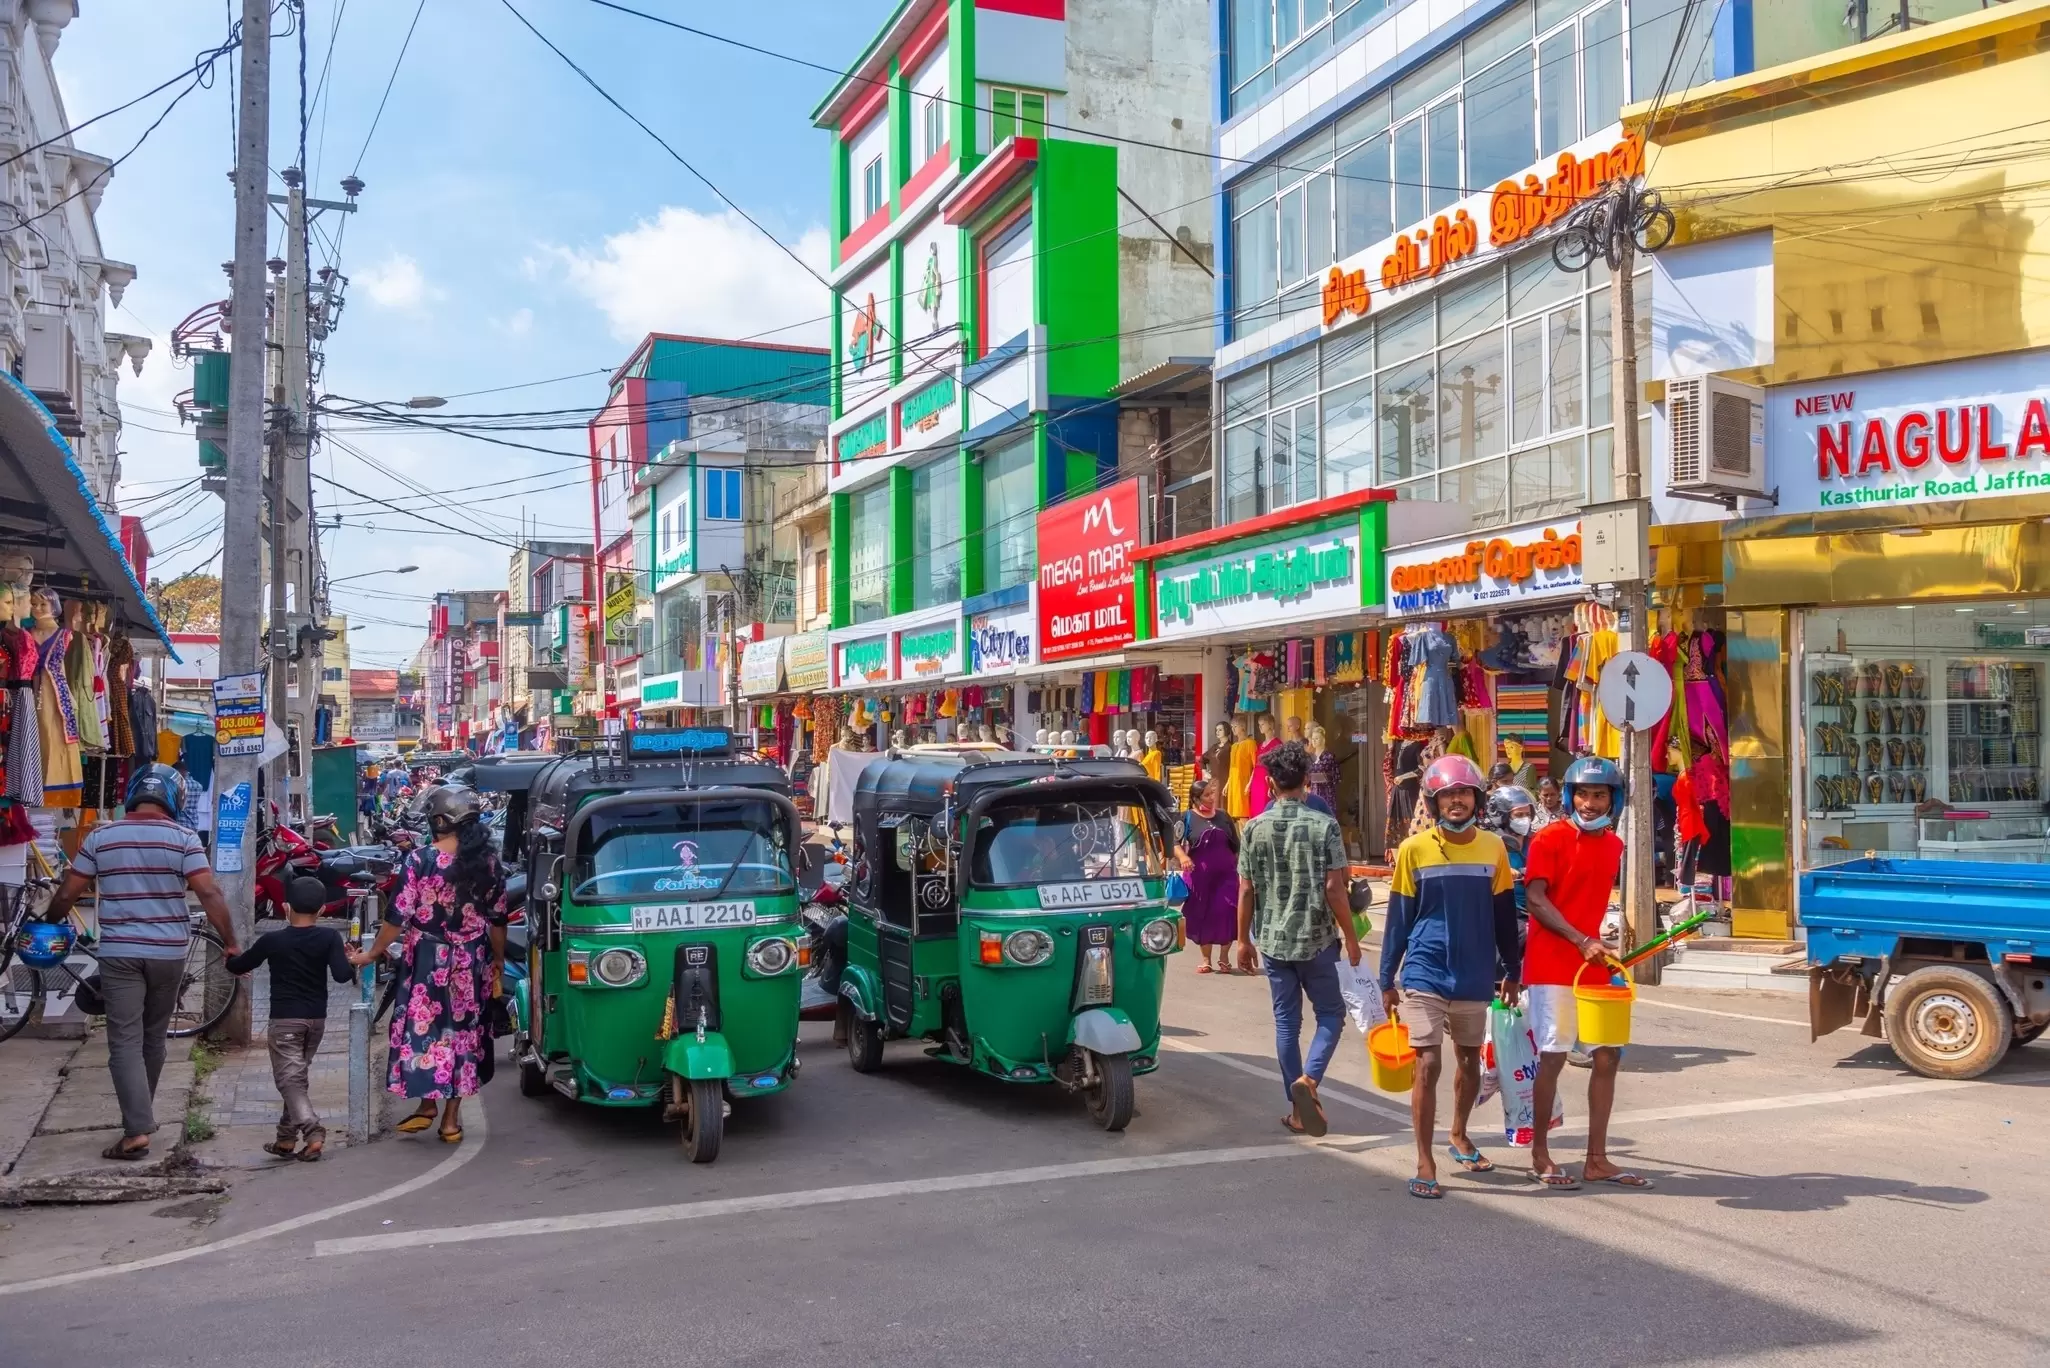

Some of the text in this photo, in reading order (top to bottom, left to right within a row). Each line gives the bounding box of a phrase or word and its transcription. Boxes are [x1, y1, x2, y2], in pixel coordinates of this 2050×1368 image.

[1795, 391, 1855, 417] NEW
[1820, 484, 1919, 506] Kasthuriar
[1042, 555, 1083, 590] MEKA
[1393, 589, 1444, 609] VANI TEX
[1480, 590, 1489, 600] 021
[1051, 594, 1128, 638] மெகா மாட்
[221, 746, 231, 754] 077
[1061, 885, 1092, 903] AAF
[1101, 882, 1143, 900] 0591
[656, 906, 694, 927] AAI
[704, 904, 753, 923] 2216
